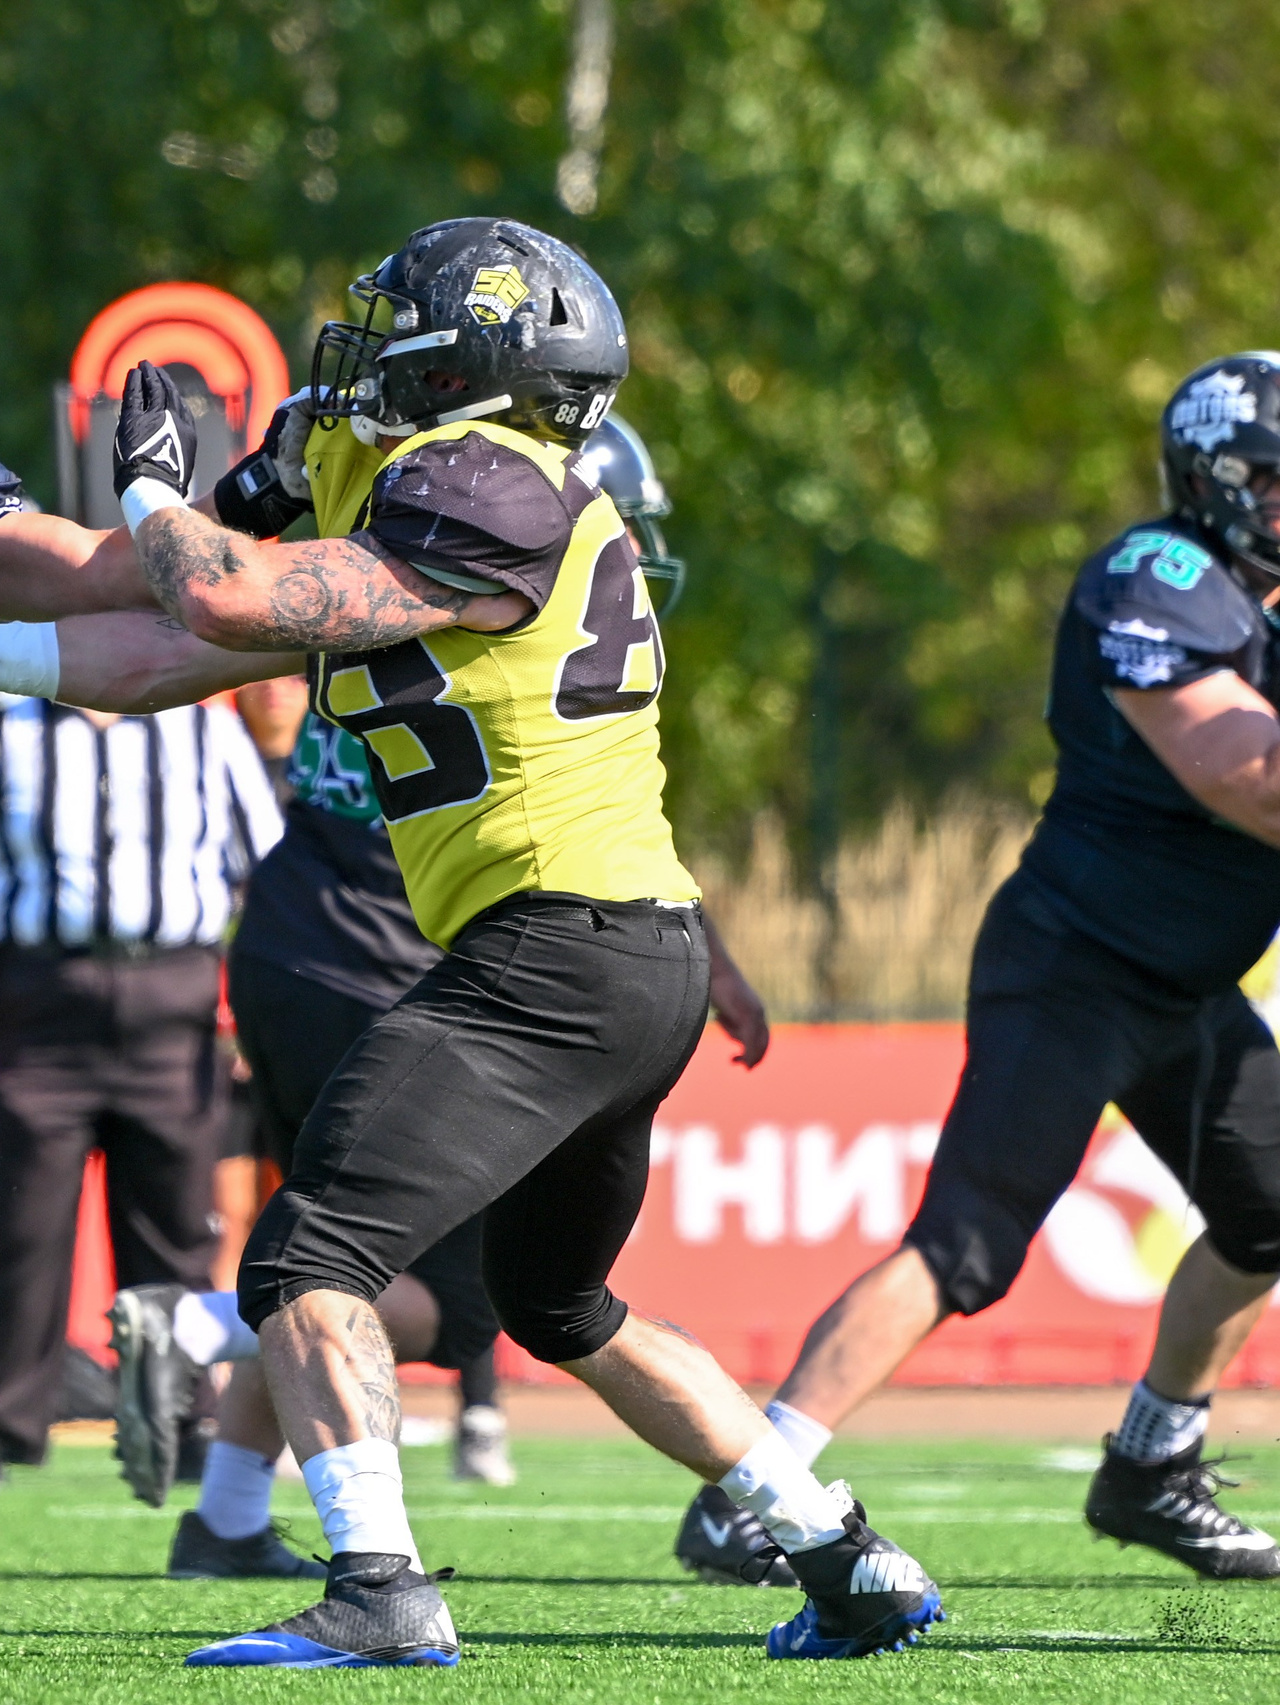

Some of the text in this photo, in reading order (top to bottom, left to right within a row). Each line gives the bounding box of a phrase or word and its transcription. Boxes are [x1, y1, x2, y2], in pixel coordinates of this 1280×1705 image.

[463, 292, 513, 324] RAIDERS
[554, 403, 580, 425] 88
[1106, 530, 1214, 591] 75
[306, 636, 493, 826] 8
[849, 1551, 925, 1595] NIKE
